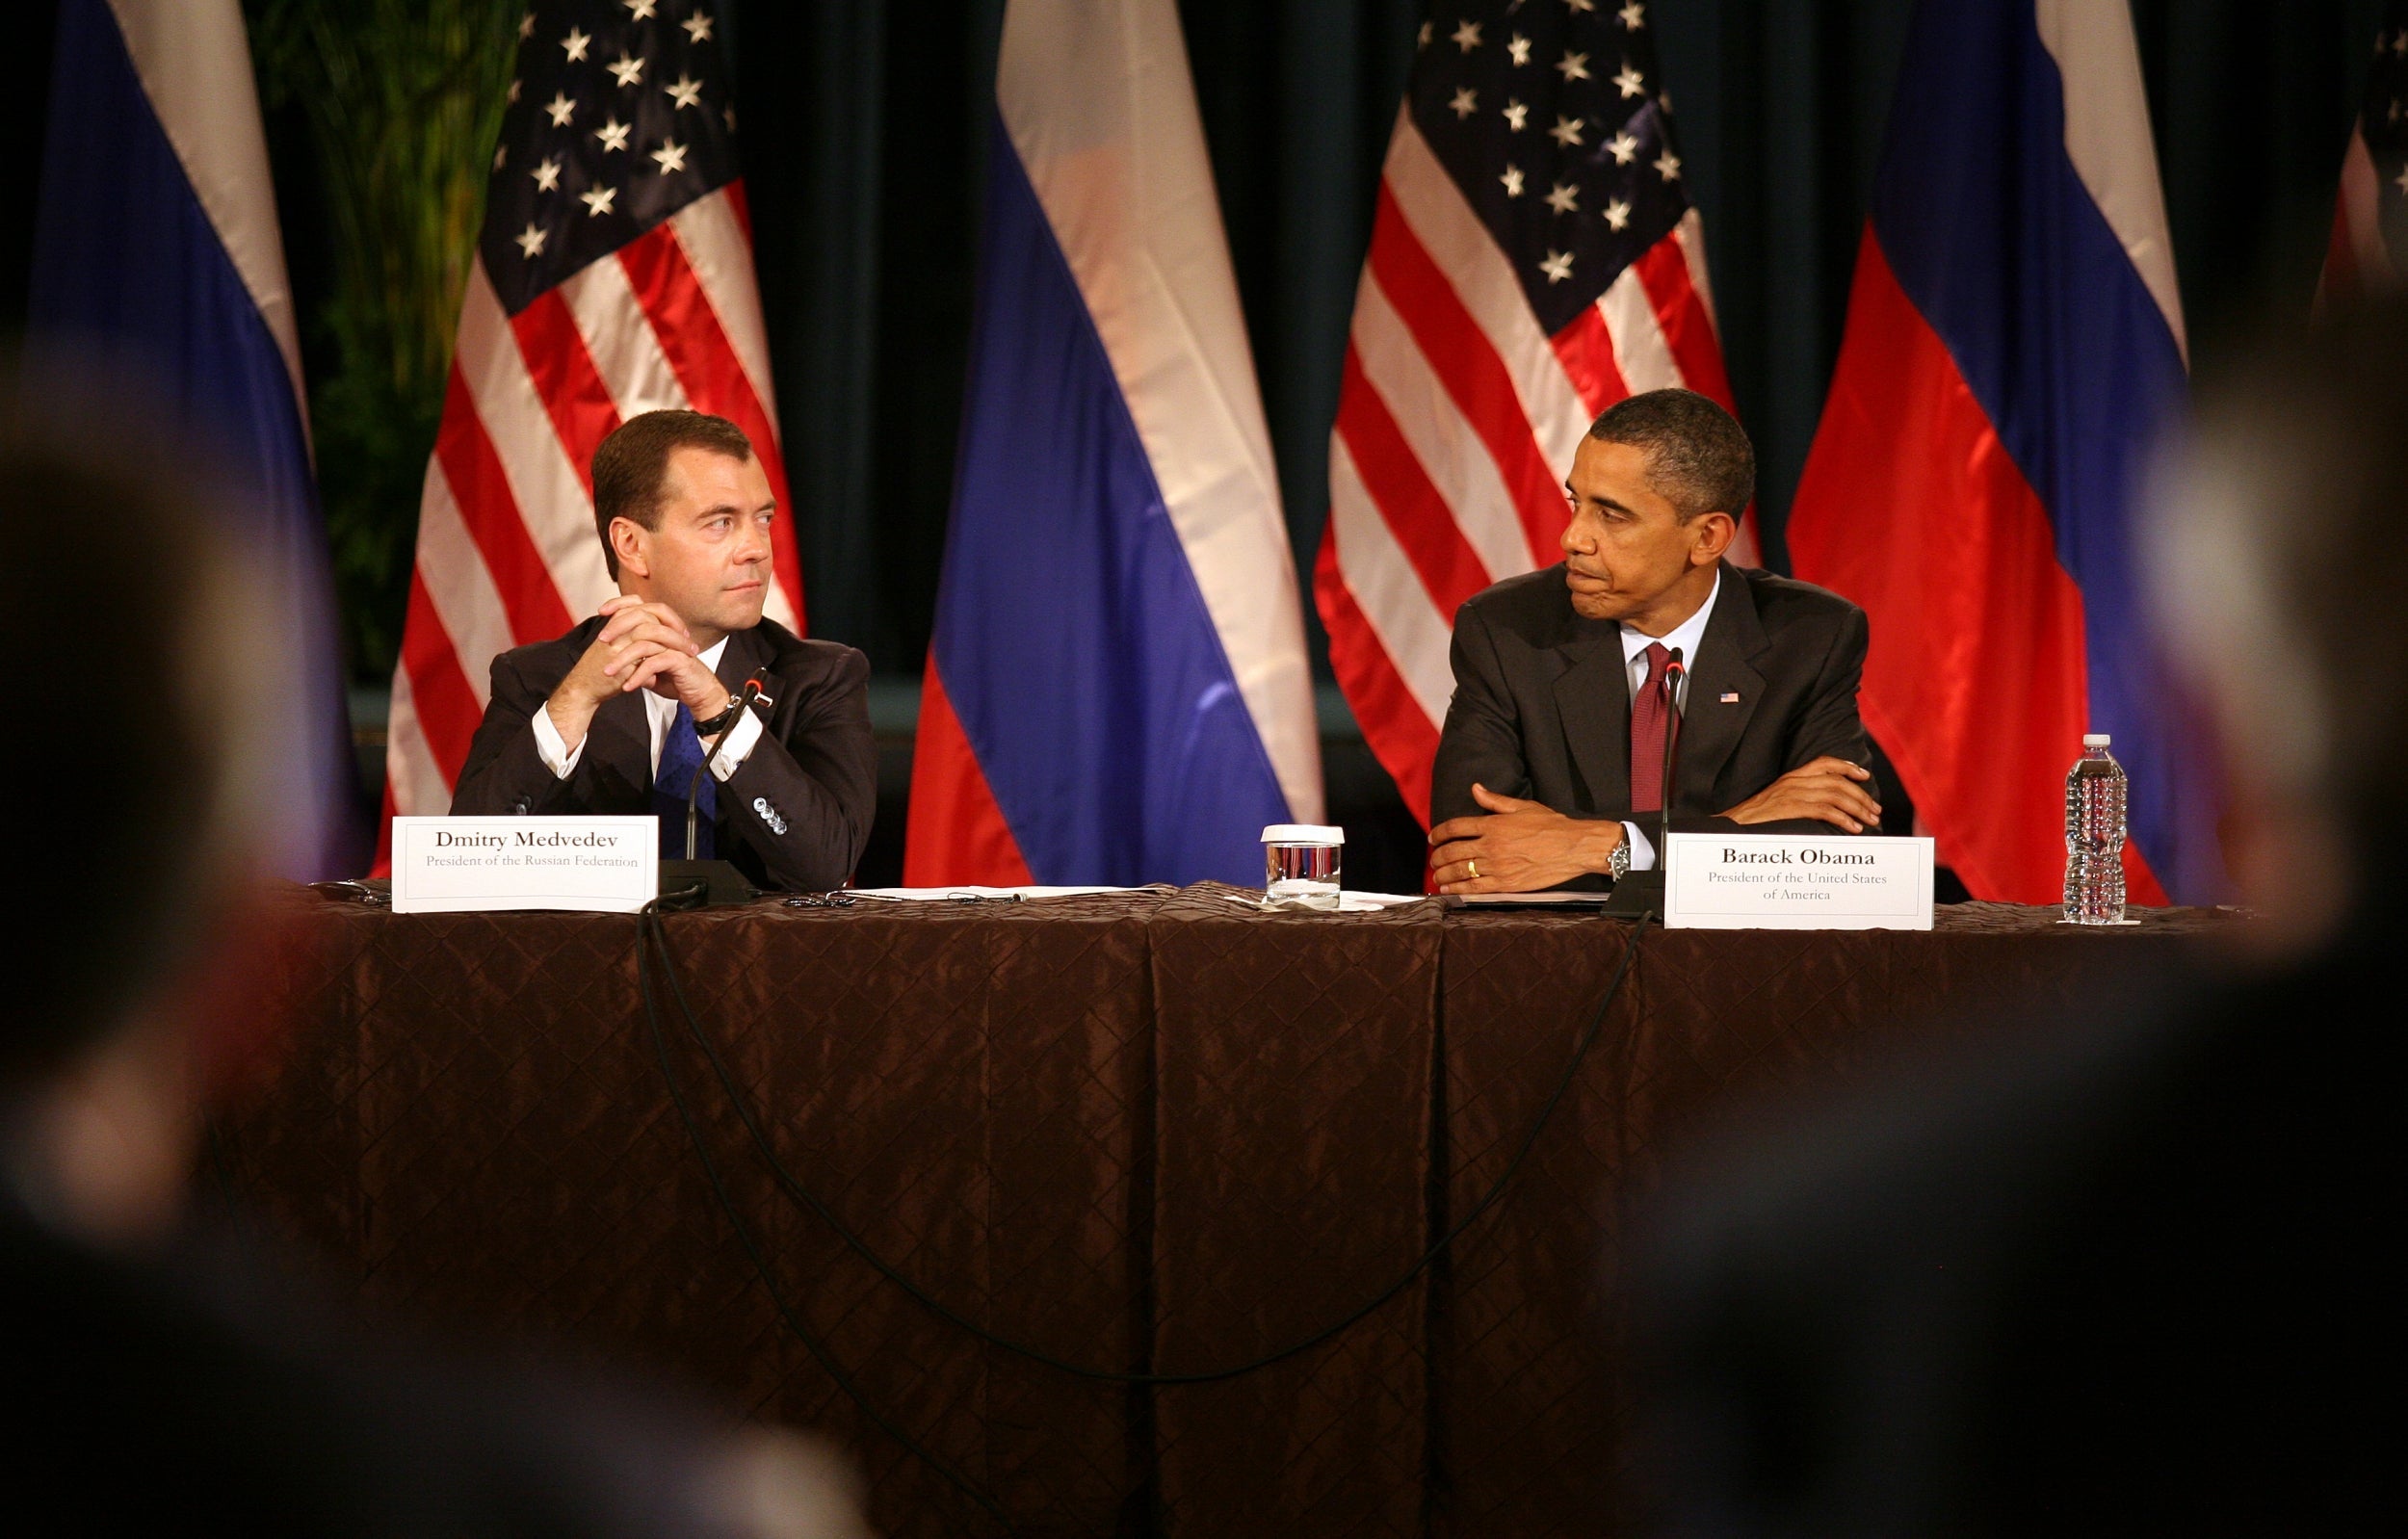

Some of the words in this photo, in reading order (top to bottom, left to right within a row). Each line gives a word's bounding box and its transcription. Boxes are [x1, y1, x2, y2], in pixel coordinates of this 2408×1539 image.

[435, 831, 508, 851] Dmitry
[514, 831, 618, 848] Medvedev
[426, 855, 482, 866] President
[484, 854, 500, 866] of
[502, 855, 521, 866] the
[525, 855, 570, 866] Russian
[575, 855, 638, 868] Federation
[1722, 848, 1793, 864] Barack
[1800, 848, 1875, 865] Obama
[1708, 872, 1764, 883] President
[1767, 872, 1783, 883] of
[1785, 873, 1803, 883] the
[1808, 873, 1848, 884] United
[1851, 874, 1887, 884] States
[1763, 889, 1778, 900] of
[1780, 889, 1830, 900] America
